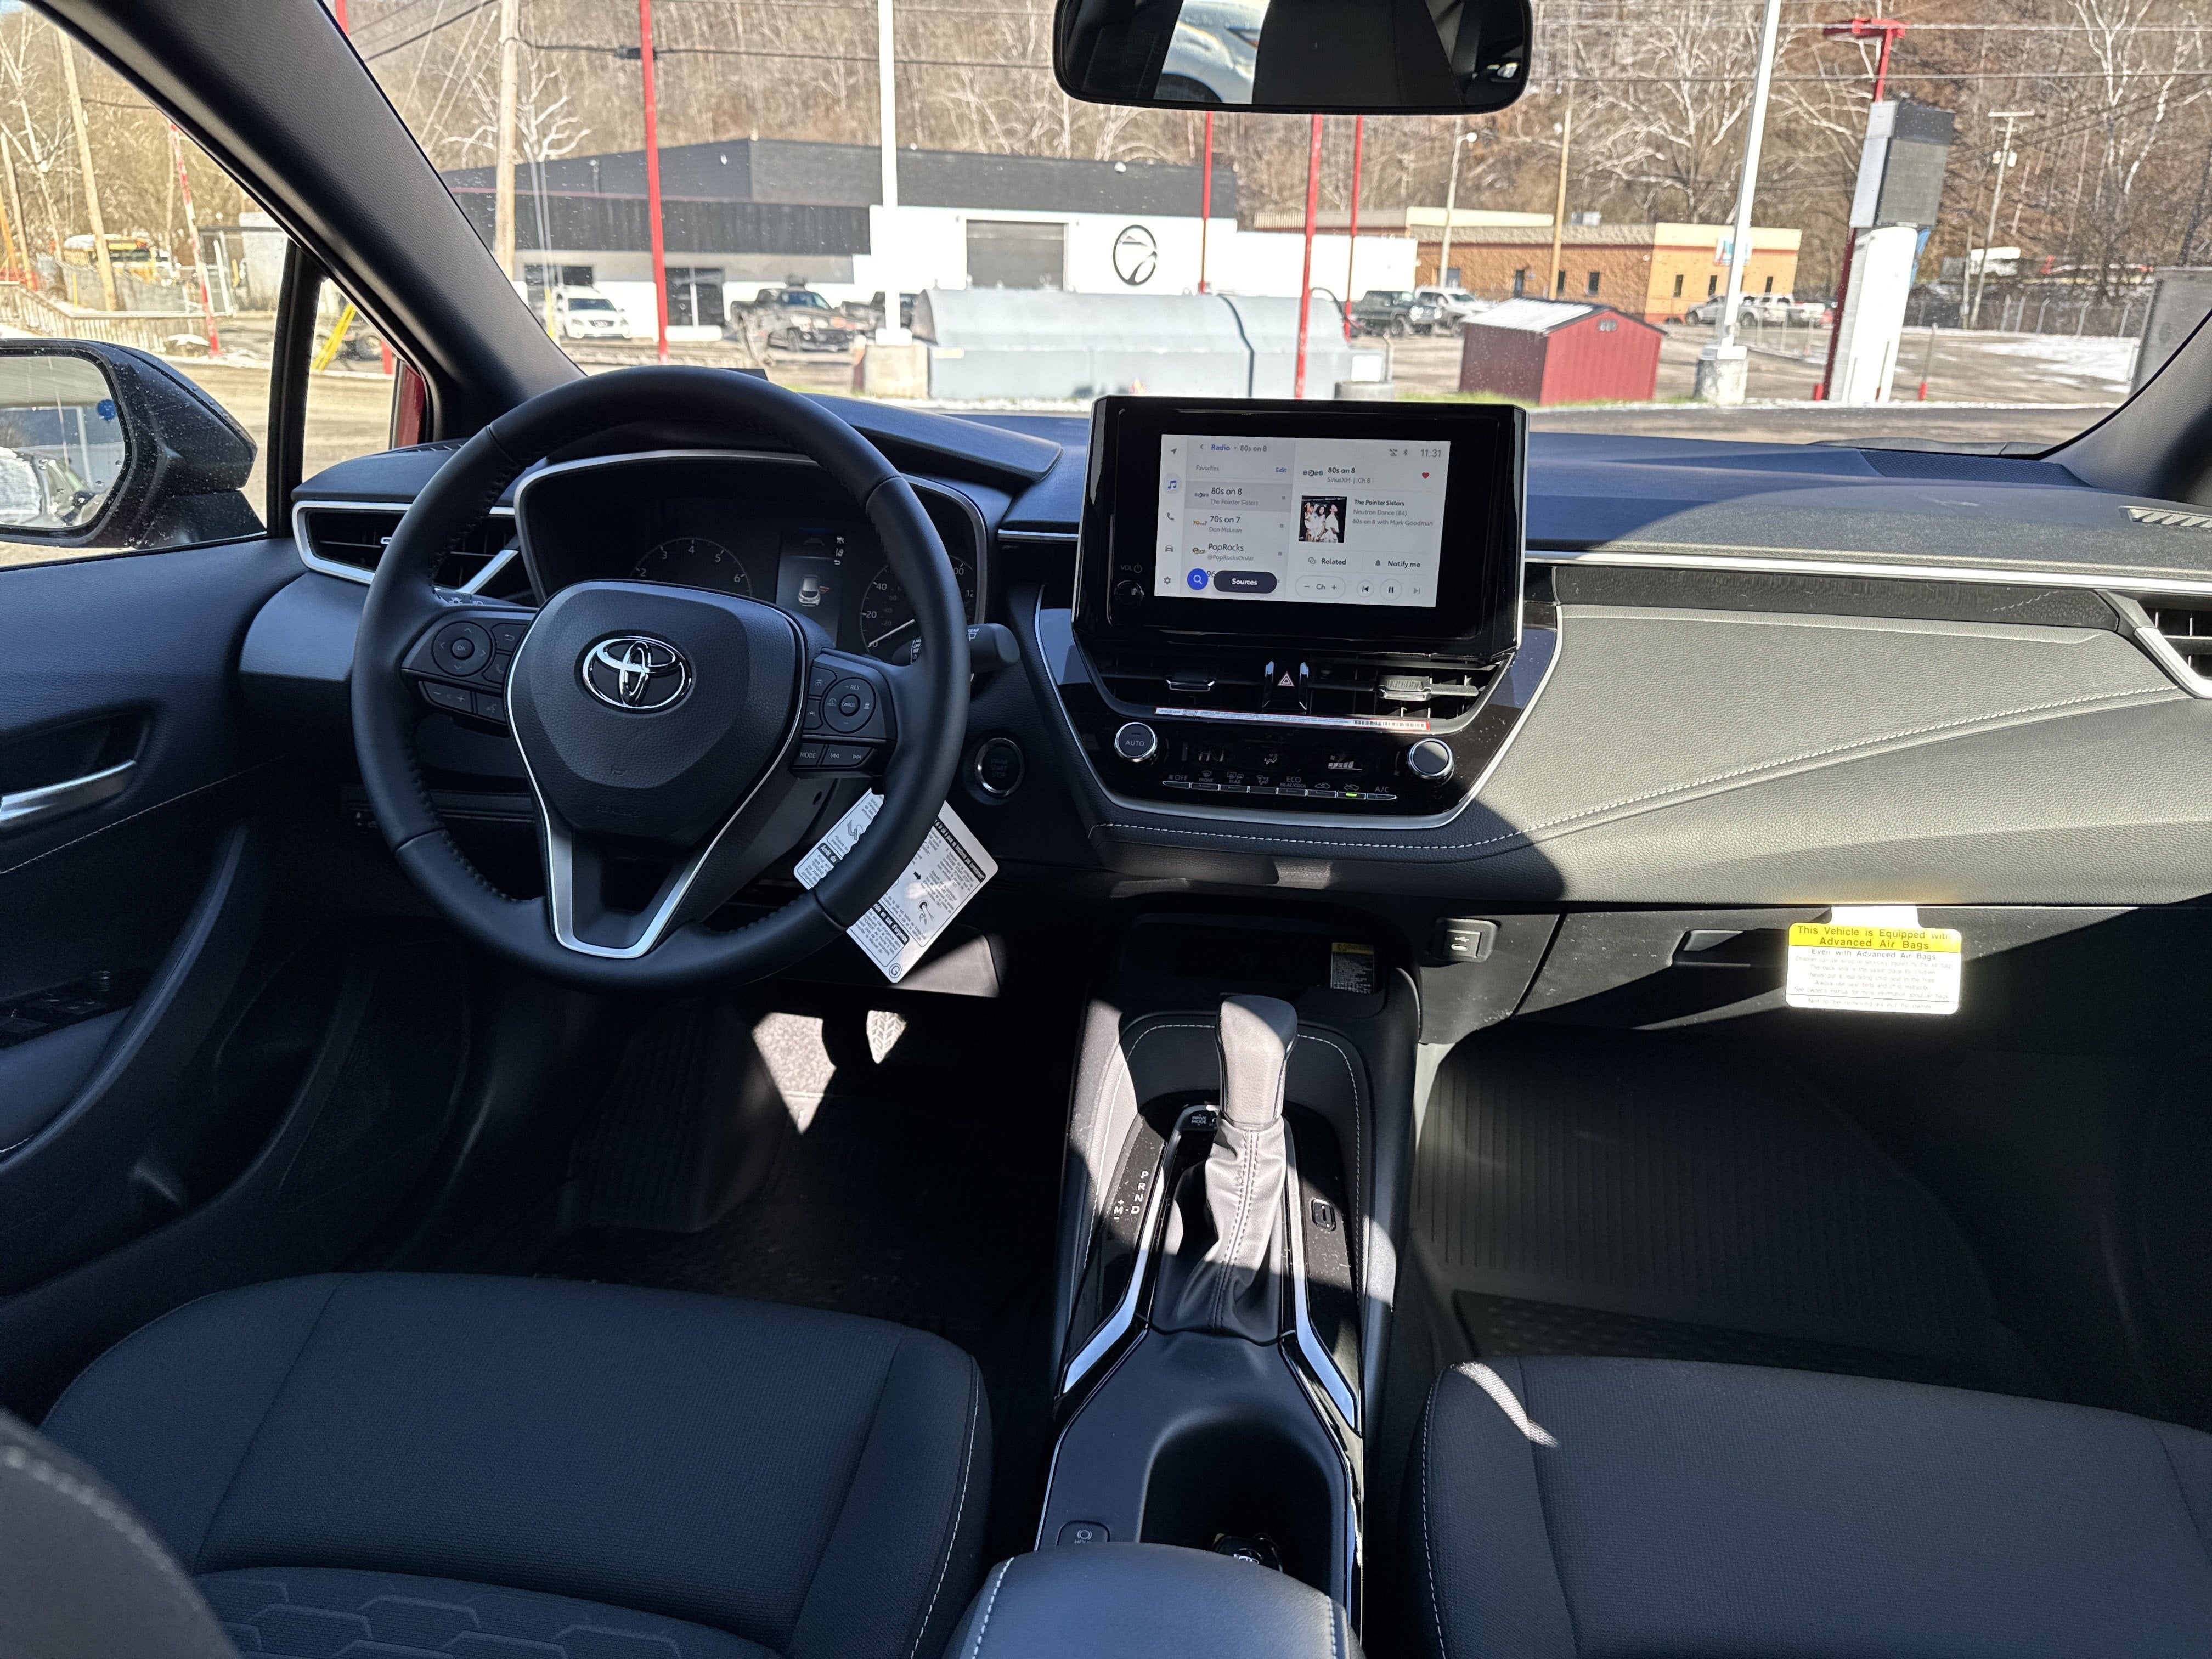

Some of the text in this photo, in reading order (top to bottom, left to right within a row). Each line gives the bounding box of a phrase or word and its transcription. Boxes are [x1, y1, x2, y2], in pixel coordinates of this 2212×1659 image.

[1420, 449, 1442, 458] 11:31
[688, 545, 695, 554] 4
[1208, 543, 1244, 552] PopRocks
[662, 551, 668, 560] 3
[715, 554, 721, 563] 5
[1387, 560, 1408, 568] Notify
[641, 568, 647, 577] 2
[733, 573, 741, 583] 6
[1798, 926, 1818, 935] This
[1824, 927, 1860, 936] Vehicle
[1865, 928, 1874, 937] is
[1879, 929, 1926, 940] Equipped
[1819, 936, 1929, 950] Advanced Air Bags
[1857, 950, 1896, 959] Advanced
[1141, 1171, 1149, 1180] P
[1137, 1182, 1146, 1191] R
[1134, 1194, 1143, 1203] N
[1113, 1206, 1141, 1215] M D
